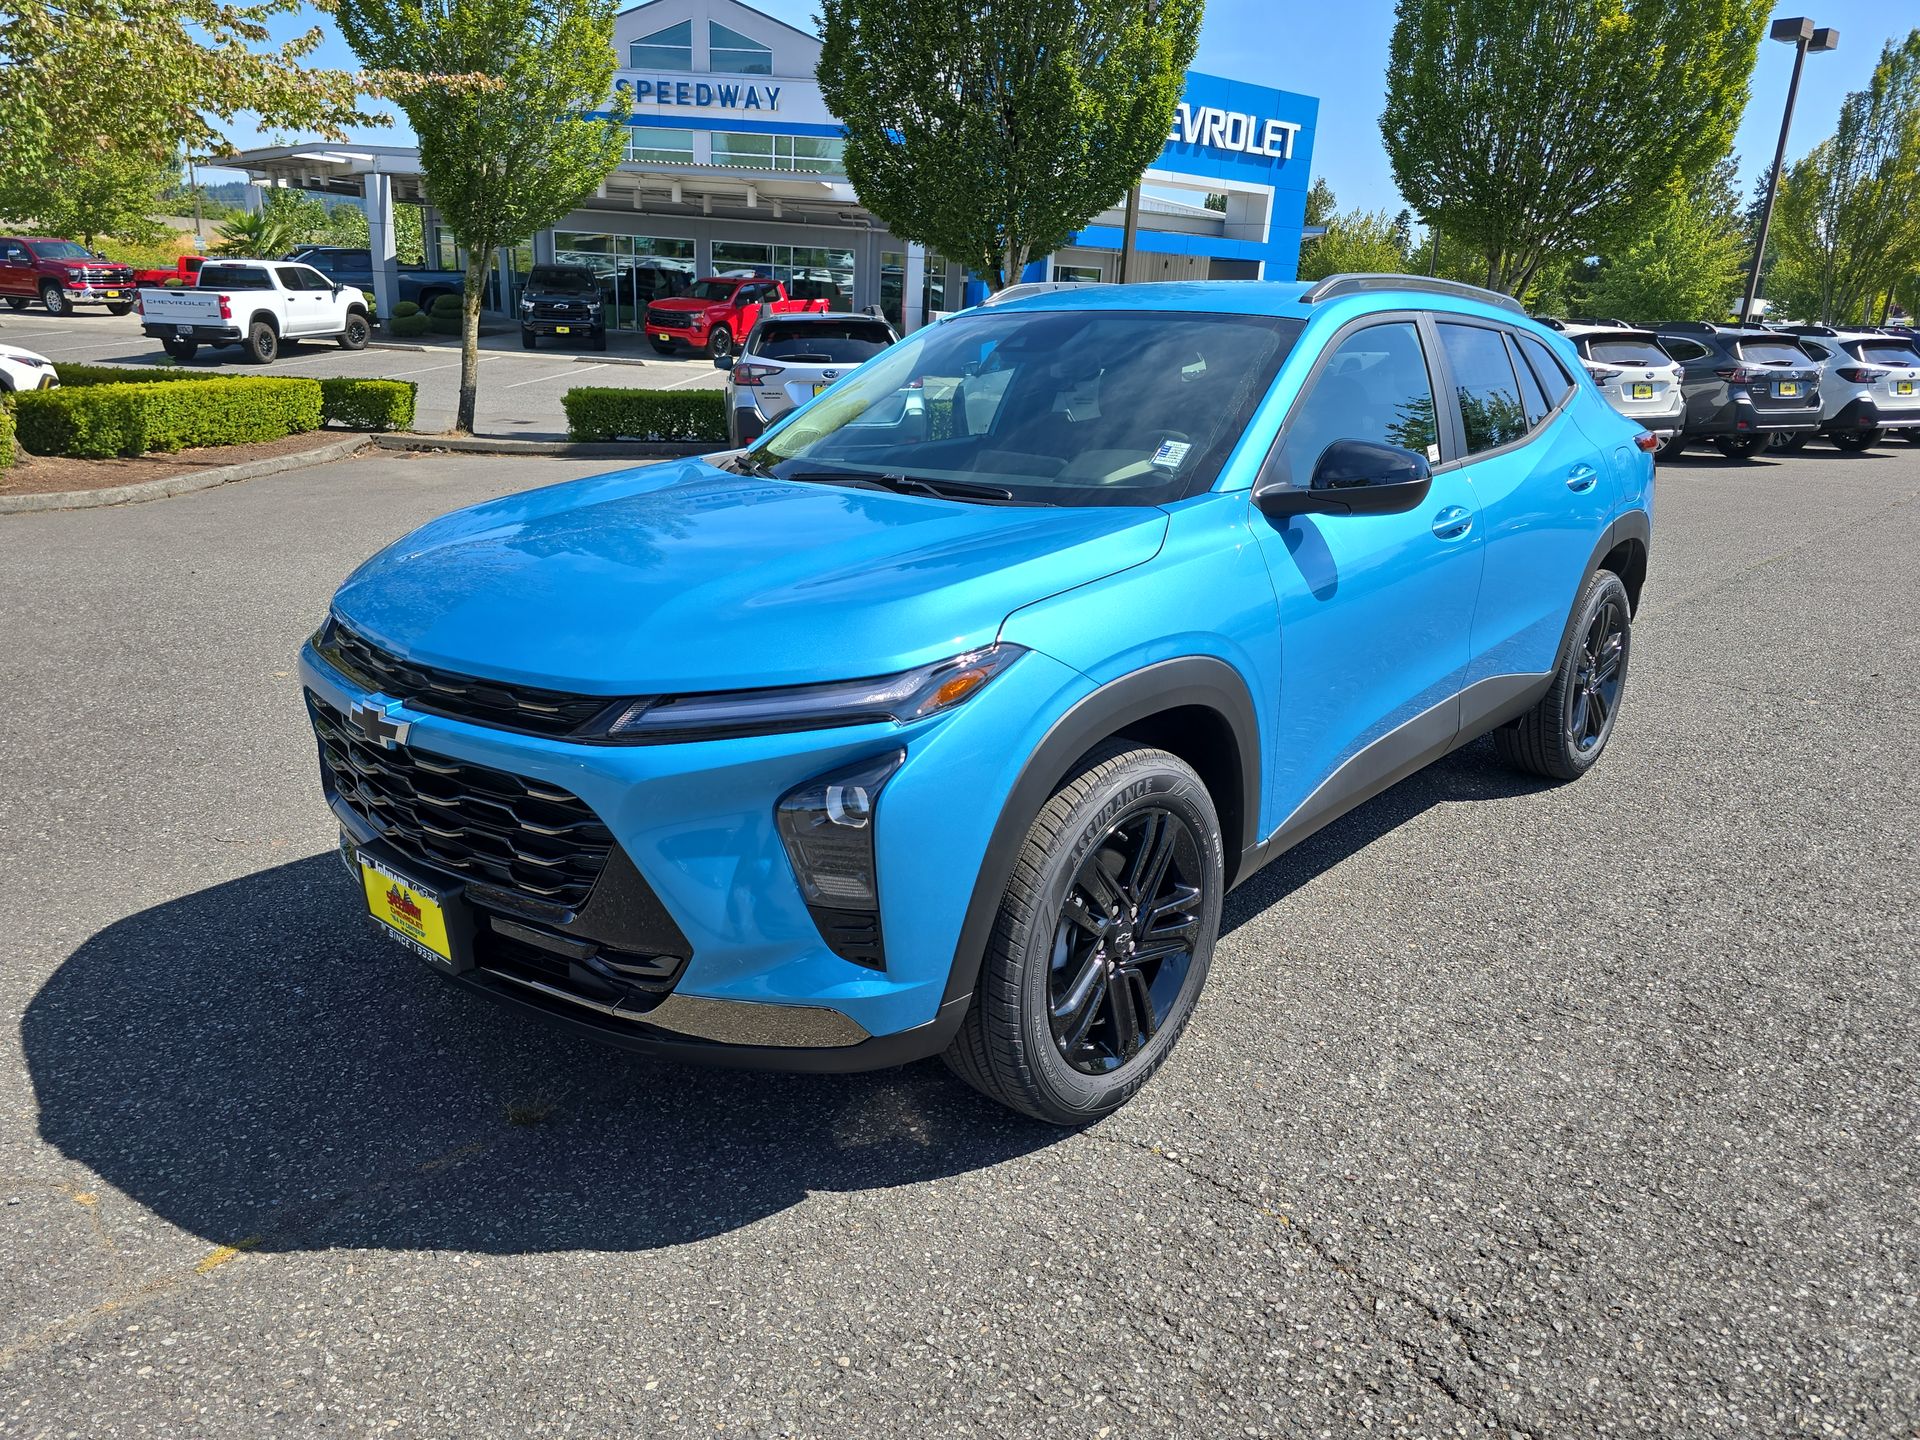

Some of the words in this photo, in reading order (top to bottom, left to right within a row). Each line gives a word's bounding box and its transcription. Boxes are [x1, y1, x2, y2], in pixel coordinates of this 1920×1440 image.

[1167, 102, 1301, 160] EVROLET
[146, 299, 212, 307] CHEVROLET
[1071, 778, 1153, 871] ASSURANCE
[388, 929, 411, 949] SINCE
[413, 944, 433, 962] 1933
